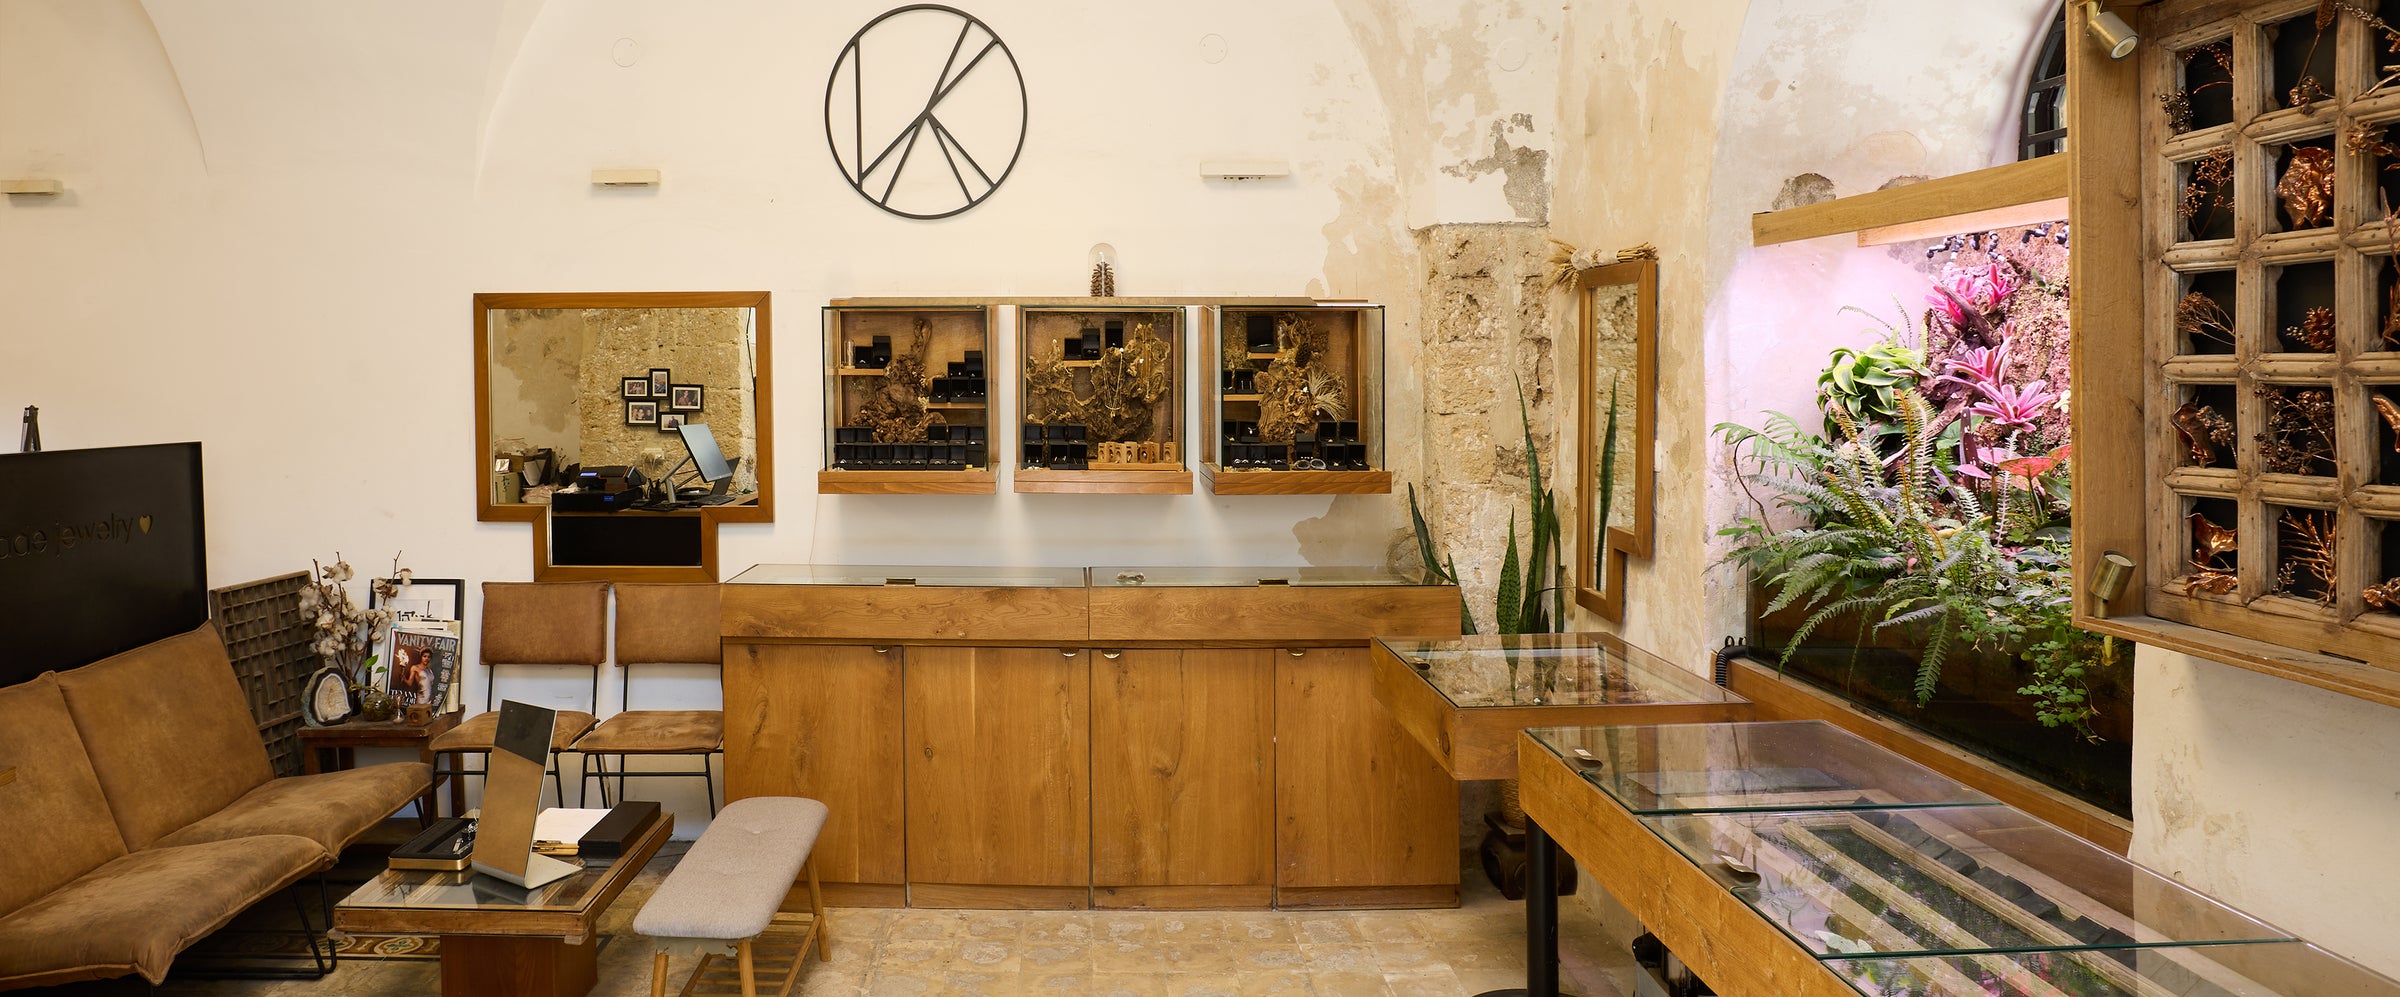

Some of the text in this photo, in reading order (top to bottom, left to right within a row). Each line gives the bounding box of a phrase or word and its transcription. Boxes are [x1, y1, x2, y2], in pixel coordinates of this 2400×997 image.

[56, 512, 134, 560] jewelry
[398, 633, 456, 652] VANITY FAIR
